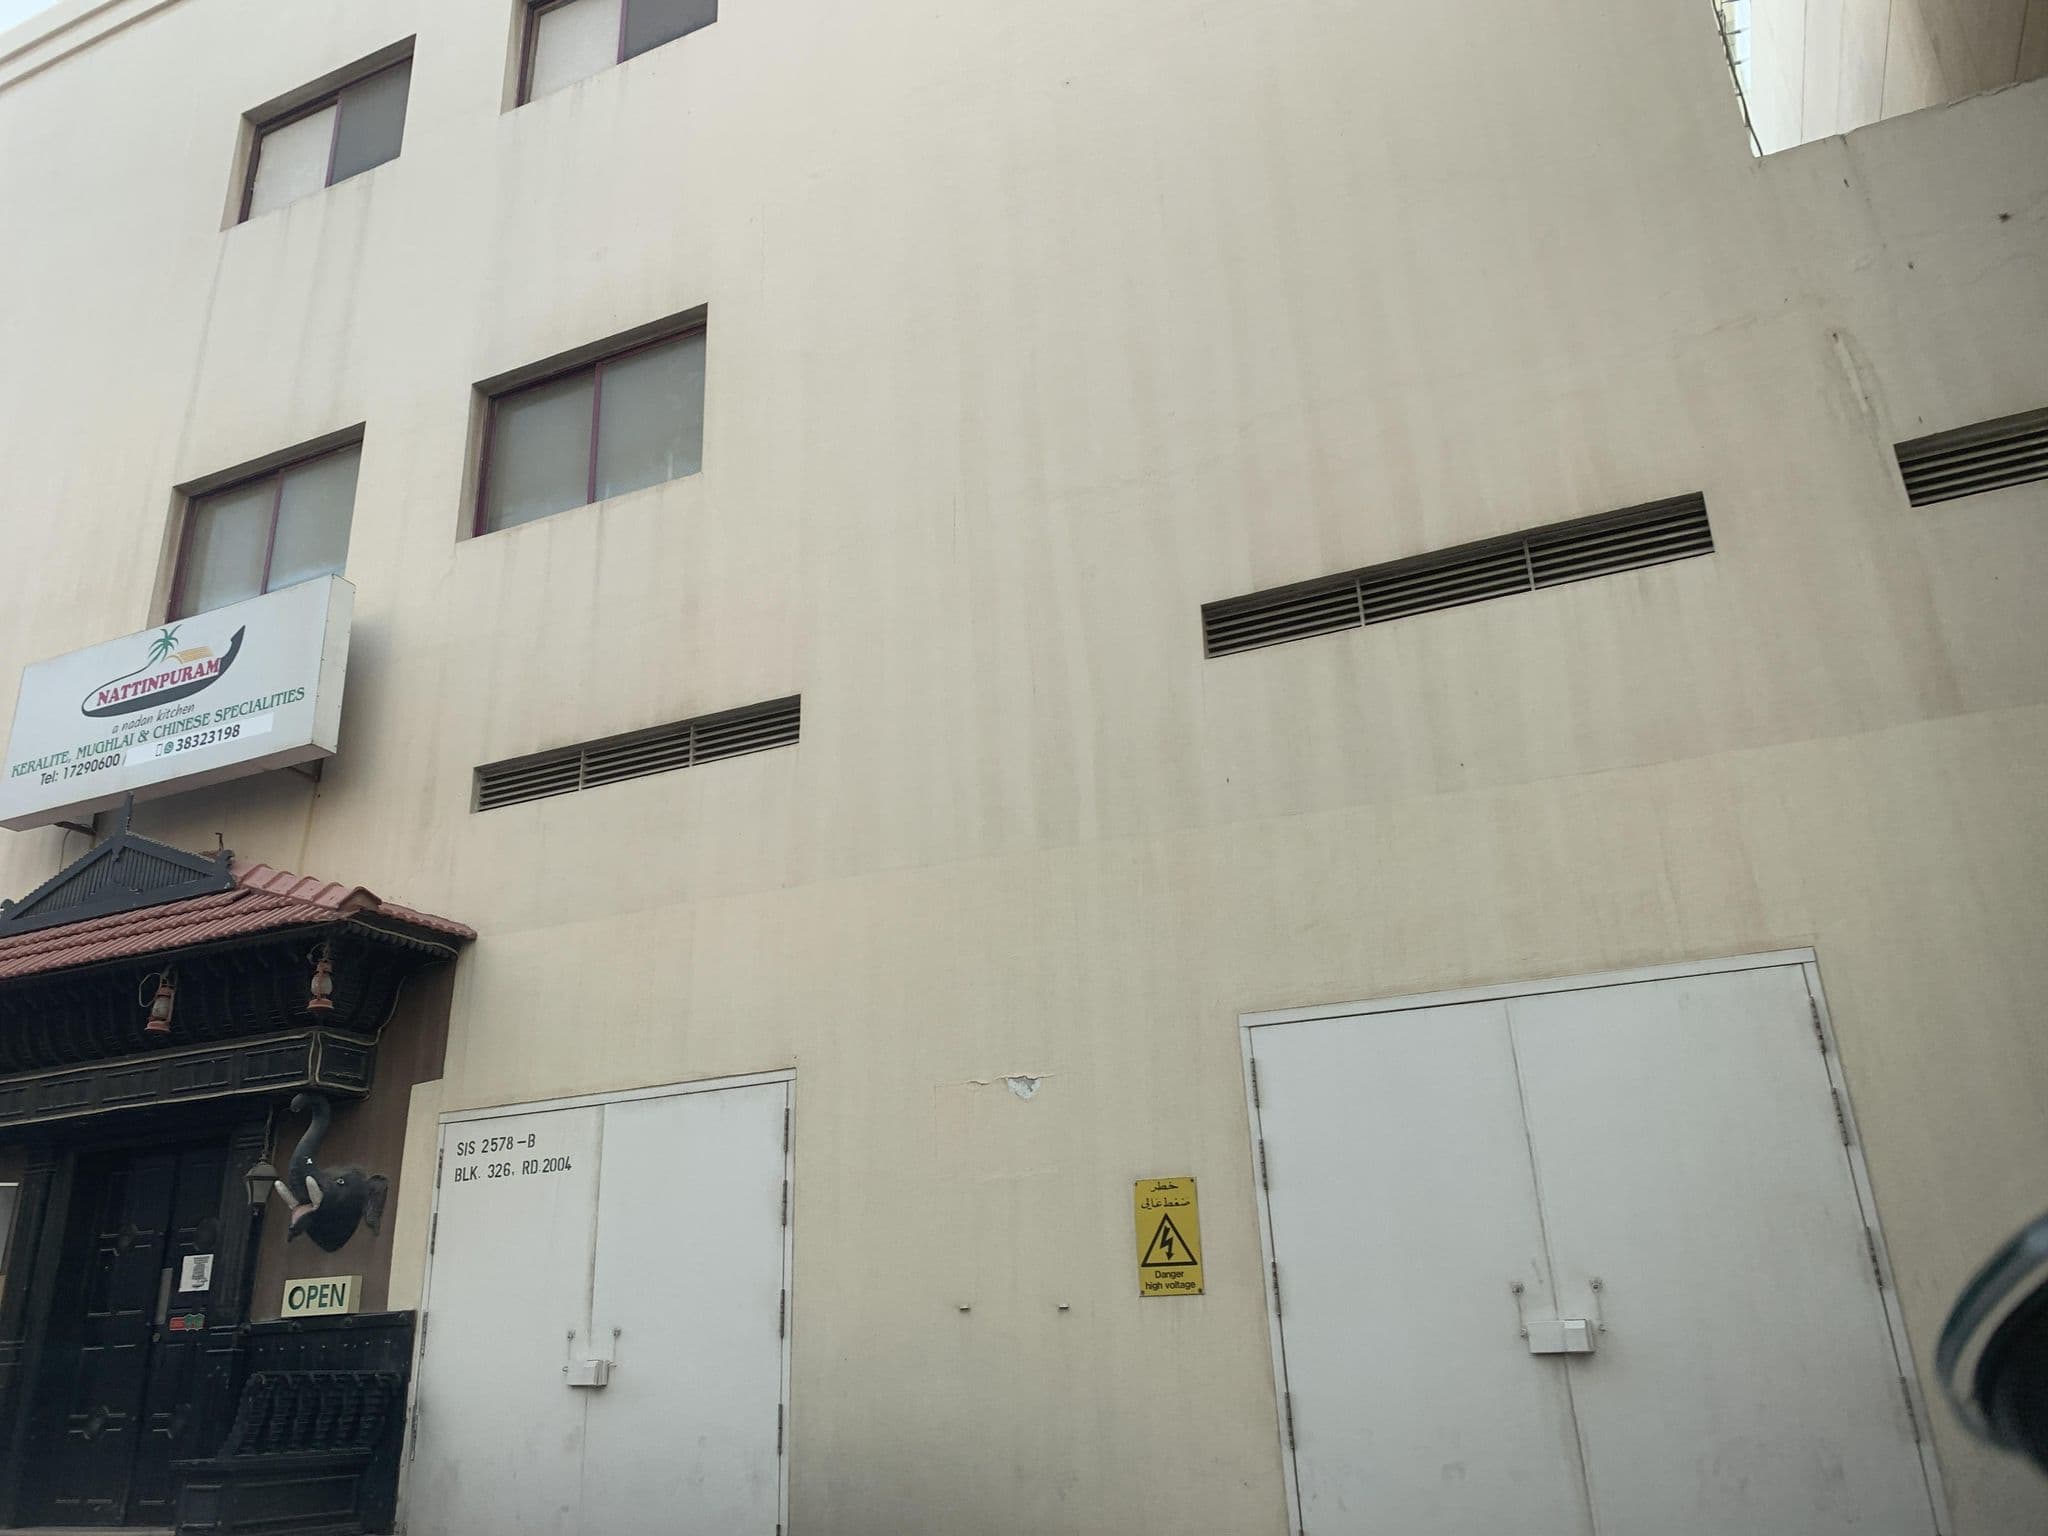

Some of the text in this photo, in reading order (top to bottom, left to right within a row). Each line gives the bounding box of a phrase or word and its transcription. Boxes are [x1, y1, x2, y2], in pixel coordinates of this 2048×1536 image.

[96, 657, 221, 707] NATTINPURAM
[112, 702, 195, 734] a nadan kitchen
[11, 686, 305, 778] KERALITE, MUGHLAI & CHINESE SPECIALITIES
[40, 771, 59, 786] Tel:
[175, 724, 241, 752] 38323198
[456, 1140, 476, 1156] SIS
[454, 1165, 481, 1182] BLK.
[1151, 1181, 1179, 1193] خطر
[1145, 1281, 1196, 1290] high voltage
[1154, 1270, 1184, 1280] Danger
[288, 1282, 346, 1310] OPEN
